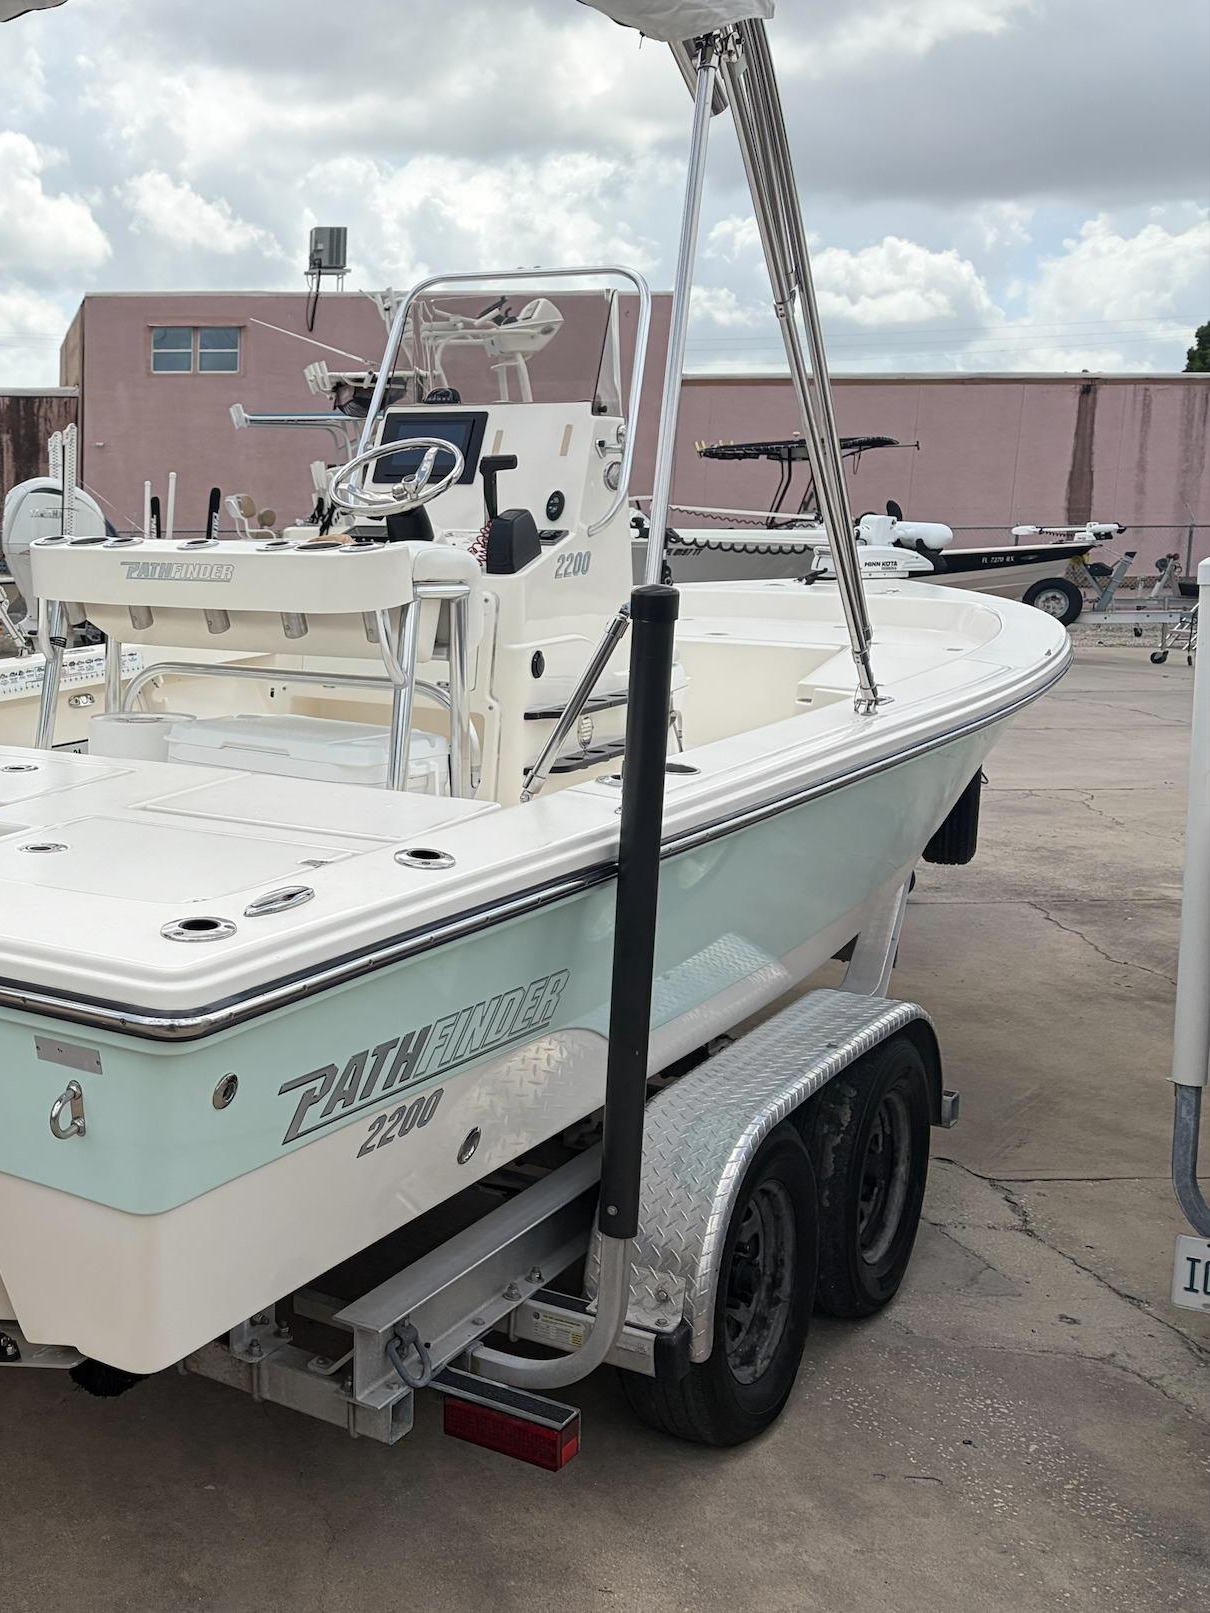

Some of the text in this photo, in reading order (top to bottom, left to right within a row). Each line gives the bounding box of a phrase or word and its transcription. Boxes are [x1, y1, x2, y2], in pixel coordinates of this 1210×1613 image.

[120, 562, 235, 582] PATHFINDER
[555, 551, 590, 579] 2200
[864, 560, 880, 568] MINN
[278, 969, 570, 1146] PATHFINDER
[357, 1088, 444, 1158] 2200
[1183, 1256, 1210, 1296] I
